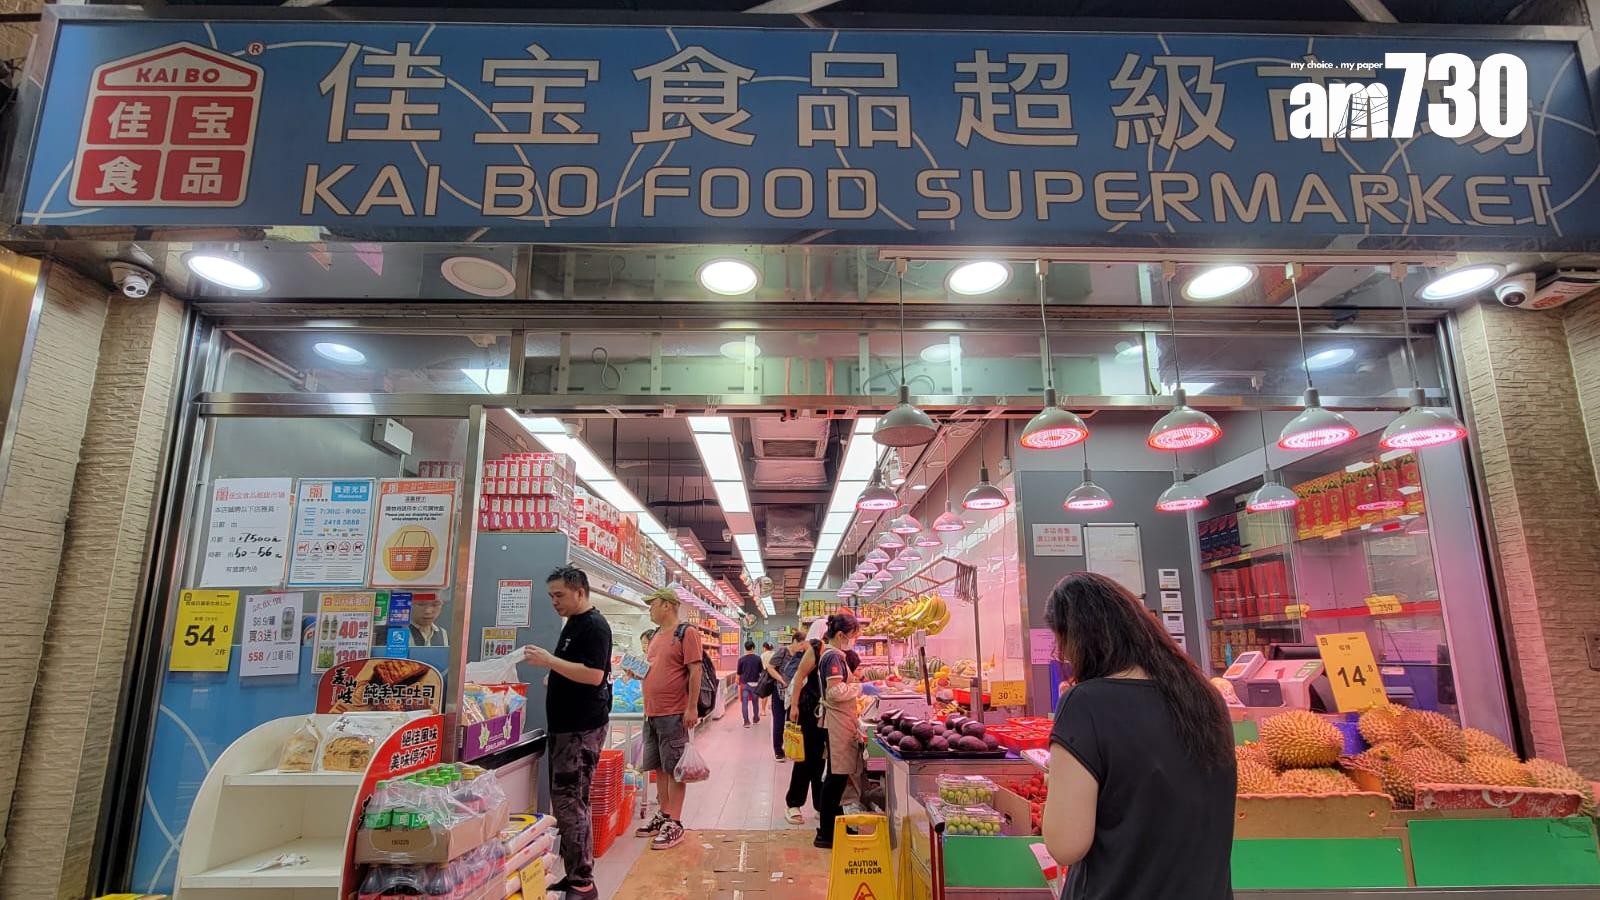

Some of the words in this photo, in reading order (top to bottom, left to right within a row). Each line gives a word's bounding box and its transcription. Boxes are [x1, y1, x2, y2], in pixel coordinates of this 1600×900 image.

[135, 67, 177, 84] KAI
[184, 67, 220, 84] BO
[301, 164, 441, 216] KAI
[482, 165, 600, 217] BO
[642, 166, 879, 220] FOOD
[915, 169, 1552, 225] SUPERMARKET
[183, 624, 215, 646] 54
[339, 620, 359, 639] 40
[1337, 665, 1367, 687] 14
[363, 684, 435, 698] 純手工吐司
[389, 746, 437, 771] 美味停不下
[860, 867, 882, 875] FLOOR
